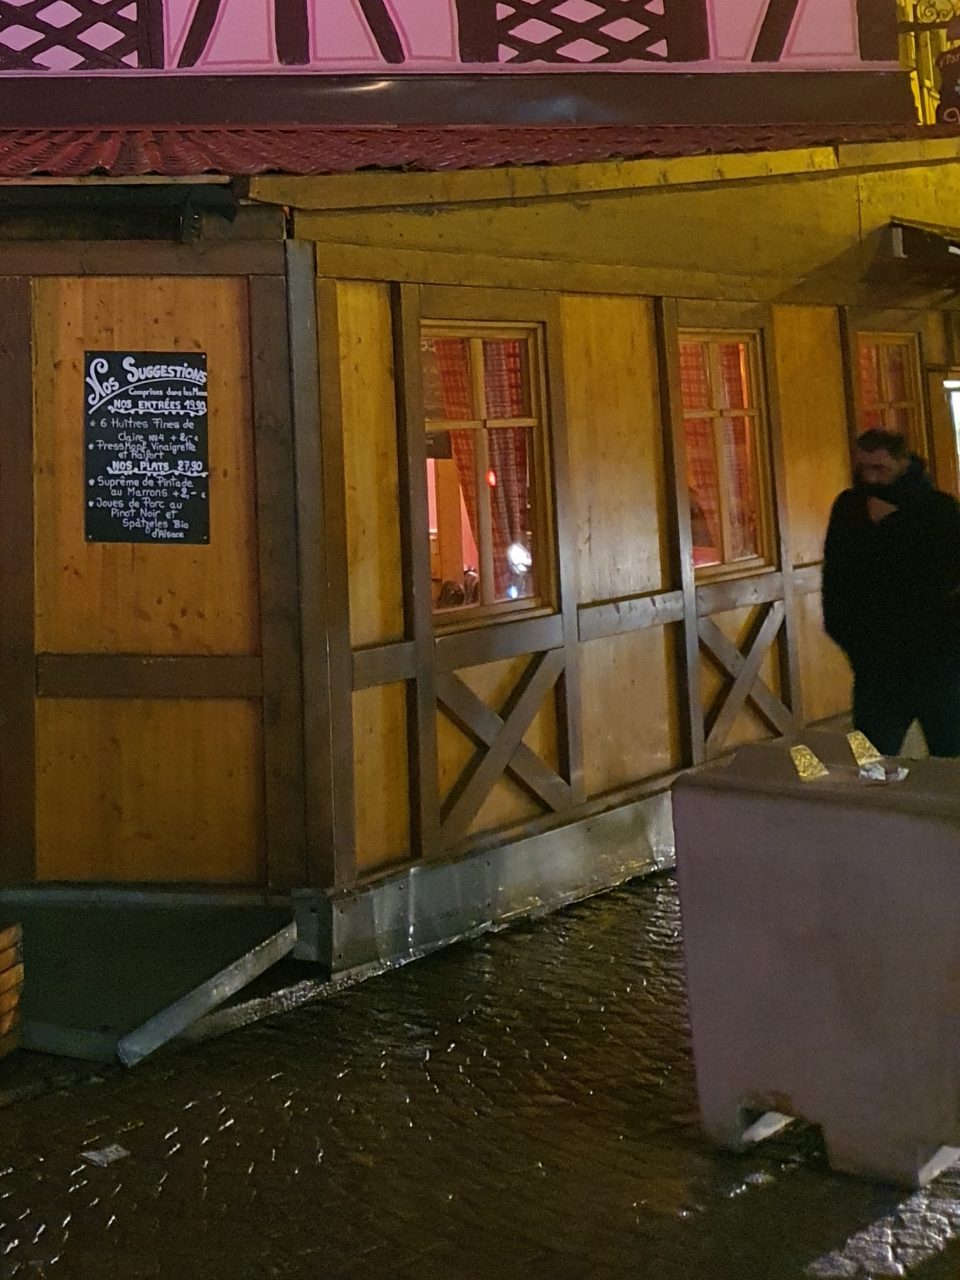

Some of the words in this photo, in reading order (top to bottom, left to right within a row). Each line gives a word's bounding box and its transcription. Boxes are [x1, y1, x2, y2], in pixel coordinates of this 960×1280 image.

[114, 399, 132, 409] NOS
[139, 398, 181, 409] ENTRÉES
[101, 419, 107, 427] 6
[183, 419, 194, 429] de
[118, 432, 143, 442] Claire
[118, 450, 127, 459] et
[112, 461, 132, 470] NOS
[141, 461, 169, 470] PLATS
[97, 477, 139, 490] Suprême
[142, 478, 154, 487] de
[127, 488, 167, 496] Marrons
[96, 499, 124, 508] Joues
[129, 498, 140, 508] de
[143, 498, 165, 509] Porc
[170, 501, 183, 509] au
[111, 509, 136, 518] Pinot
[140, 508, 161, 518] Noir
[165, 510, 178, 519] et
[174, 520, 188, 528] Bio
